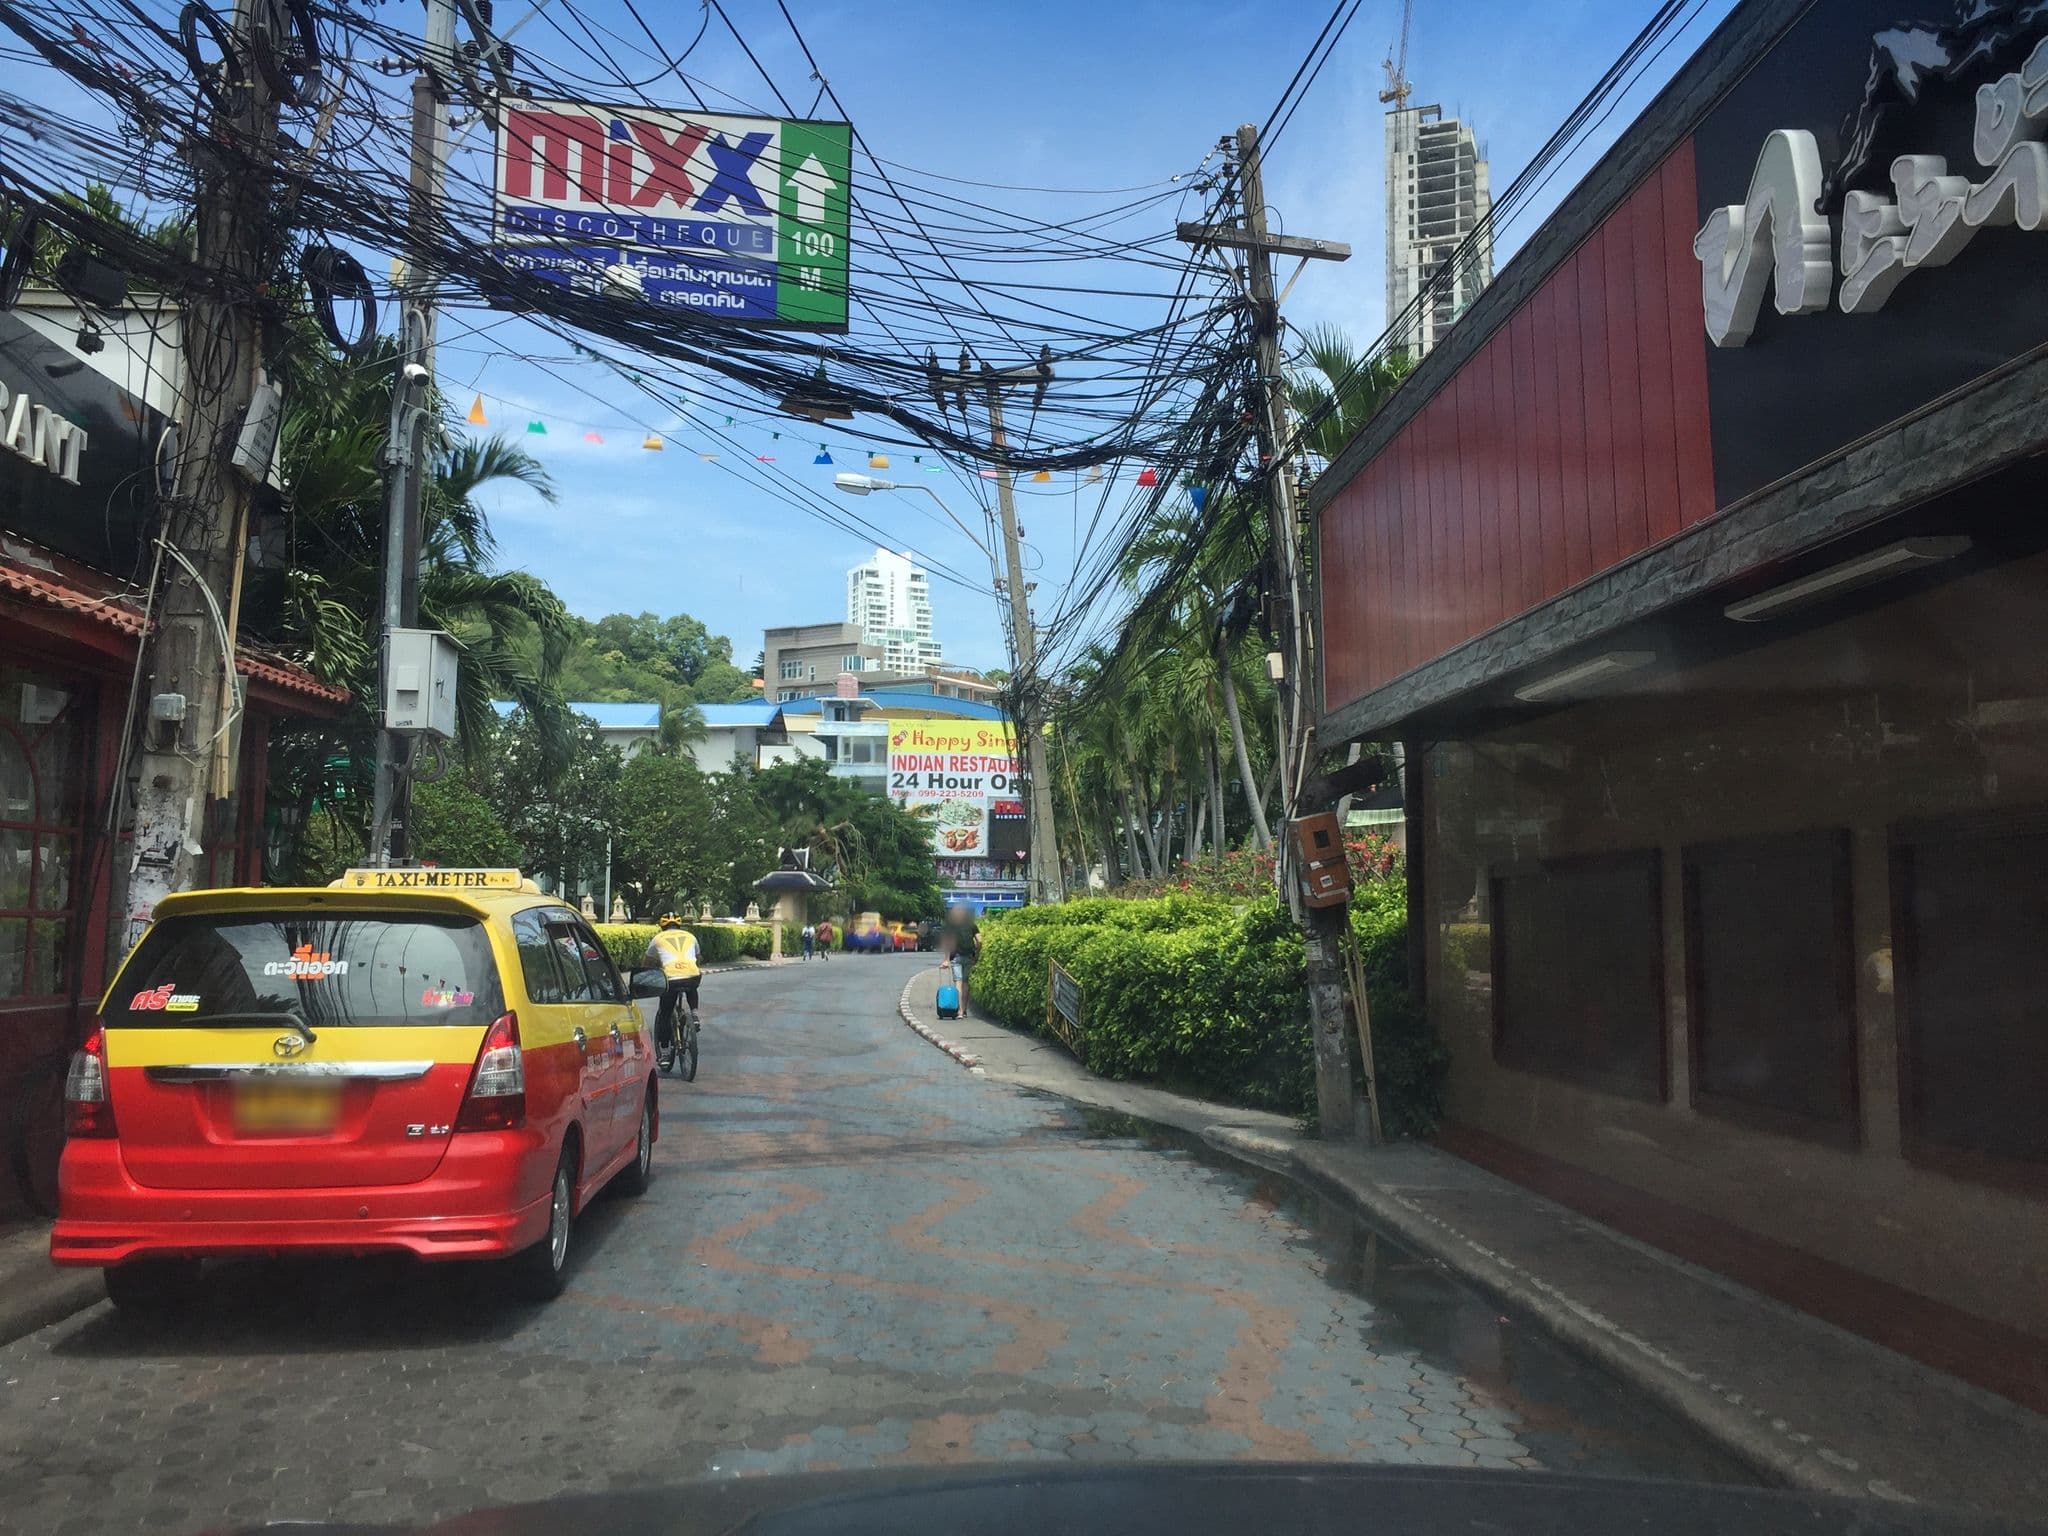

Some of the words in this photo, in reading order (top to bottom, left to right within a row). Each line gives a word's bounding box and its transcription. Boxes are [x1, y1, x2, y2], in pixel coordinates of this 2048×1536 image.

[511, 214, 765, 249] DISCOTHEQUE
[792, 231, 834, 257] 100
[0, 377, 89, 487] ANT
[912, 729, 971, 752] Happy
[892, 755, 944, 772] INDIAN
[892, 773, 919, 788] 24
[928, 775, 983, 790] Hour
[376, 871, 488, 888] TAXI-METER
[264, 956, 349, 976] ตะวันออก
